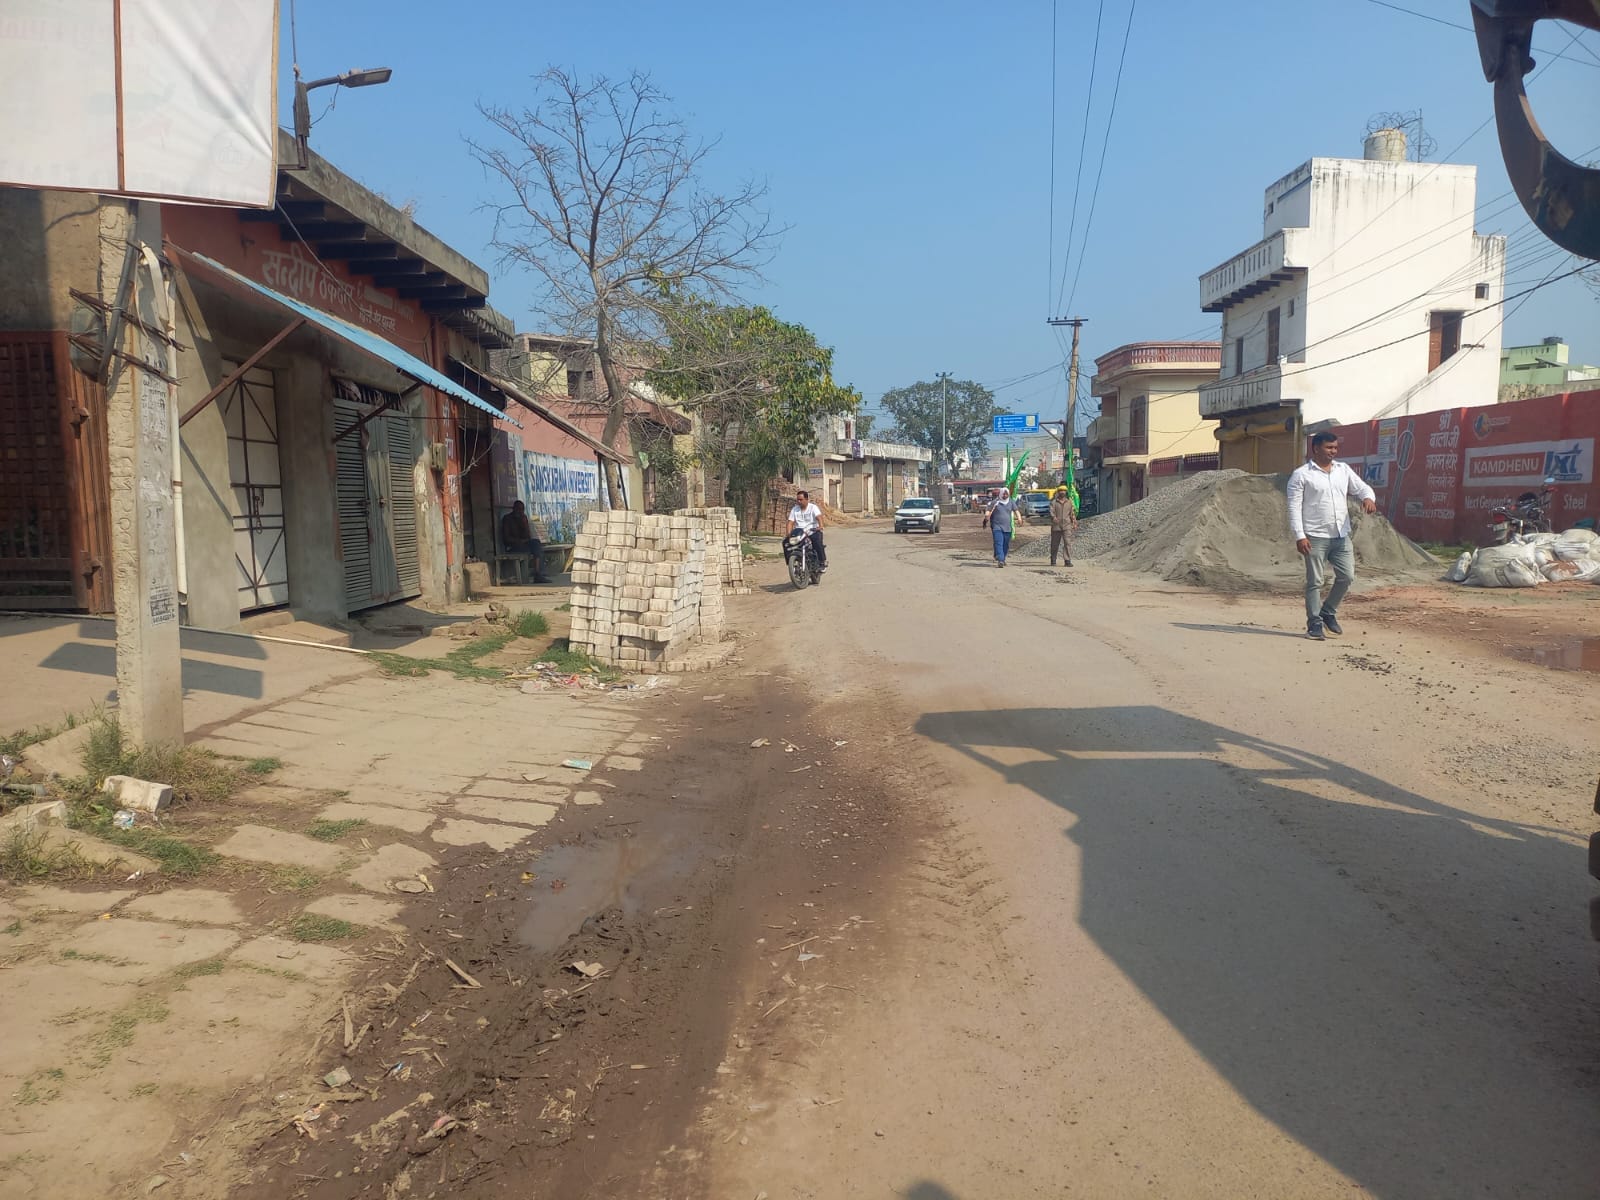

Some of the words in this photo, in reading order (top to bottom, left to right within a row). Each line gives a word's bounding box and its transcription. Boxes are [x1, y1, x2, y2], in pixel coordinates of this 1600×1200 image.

[1439, 410, 1452, 431] श्री
[1429, 425, 1460, 449] बालाजी
[1473, 458, 1540, 473] KAMDHENU
[530, 463, 567, 493] SANSKARAM
[567, 470, 596, 494] UNIVERSITY
[1465, 495, 1479, 509] Next
[1563, 491, 1588, 510] Steel
